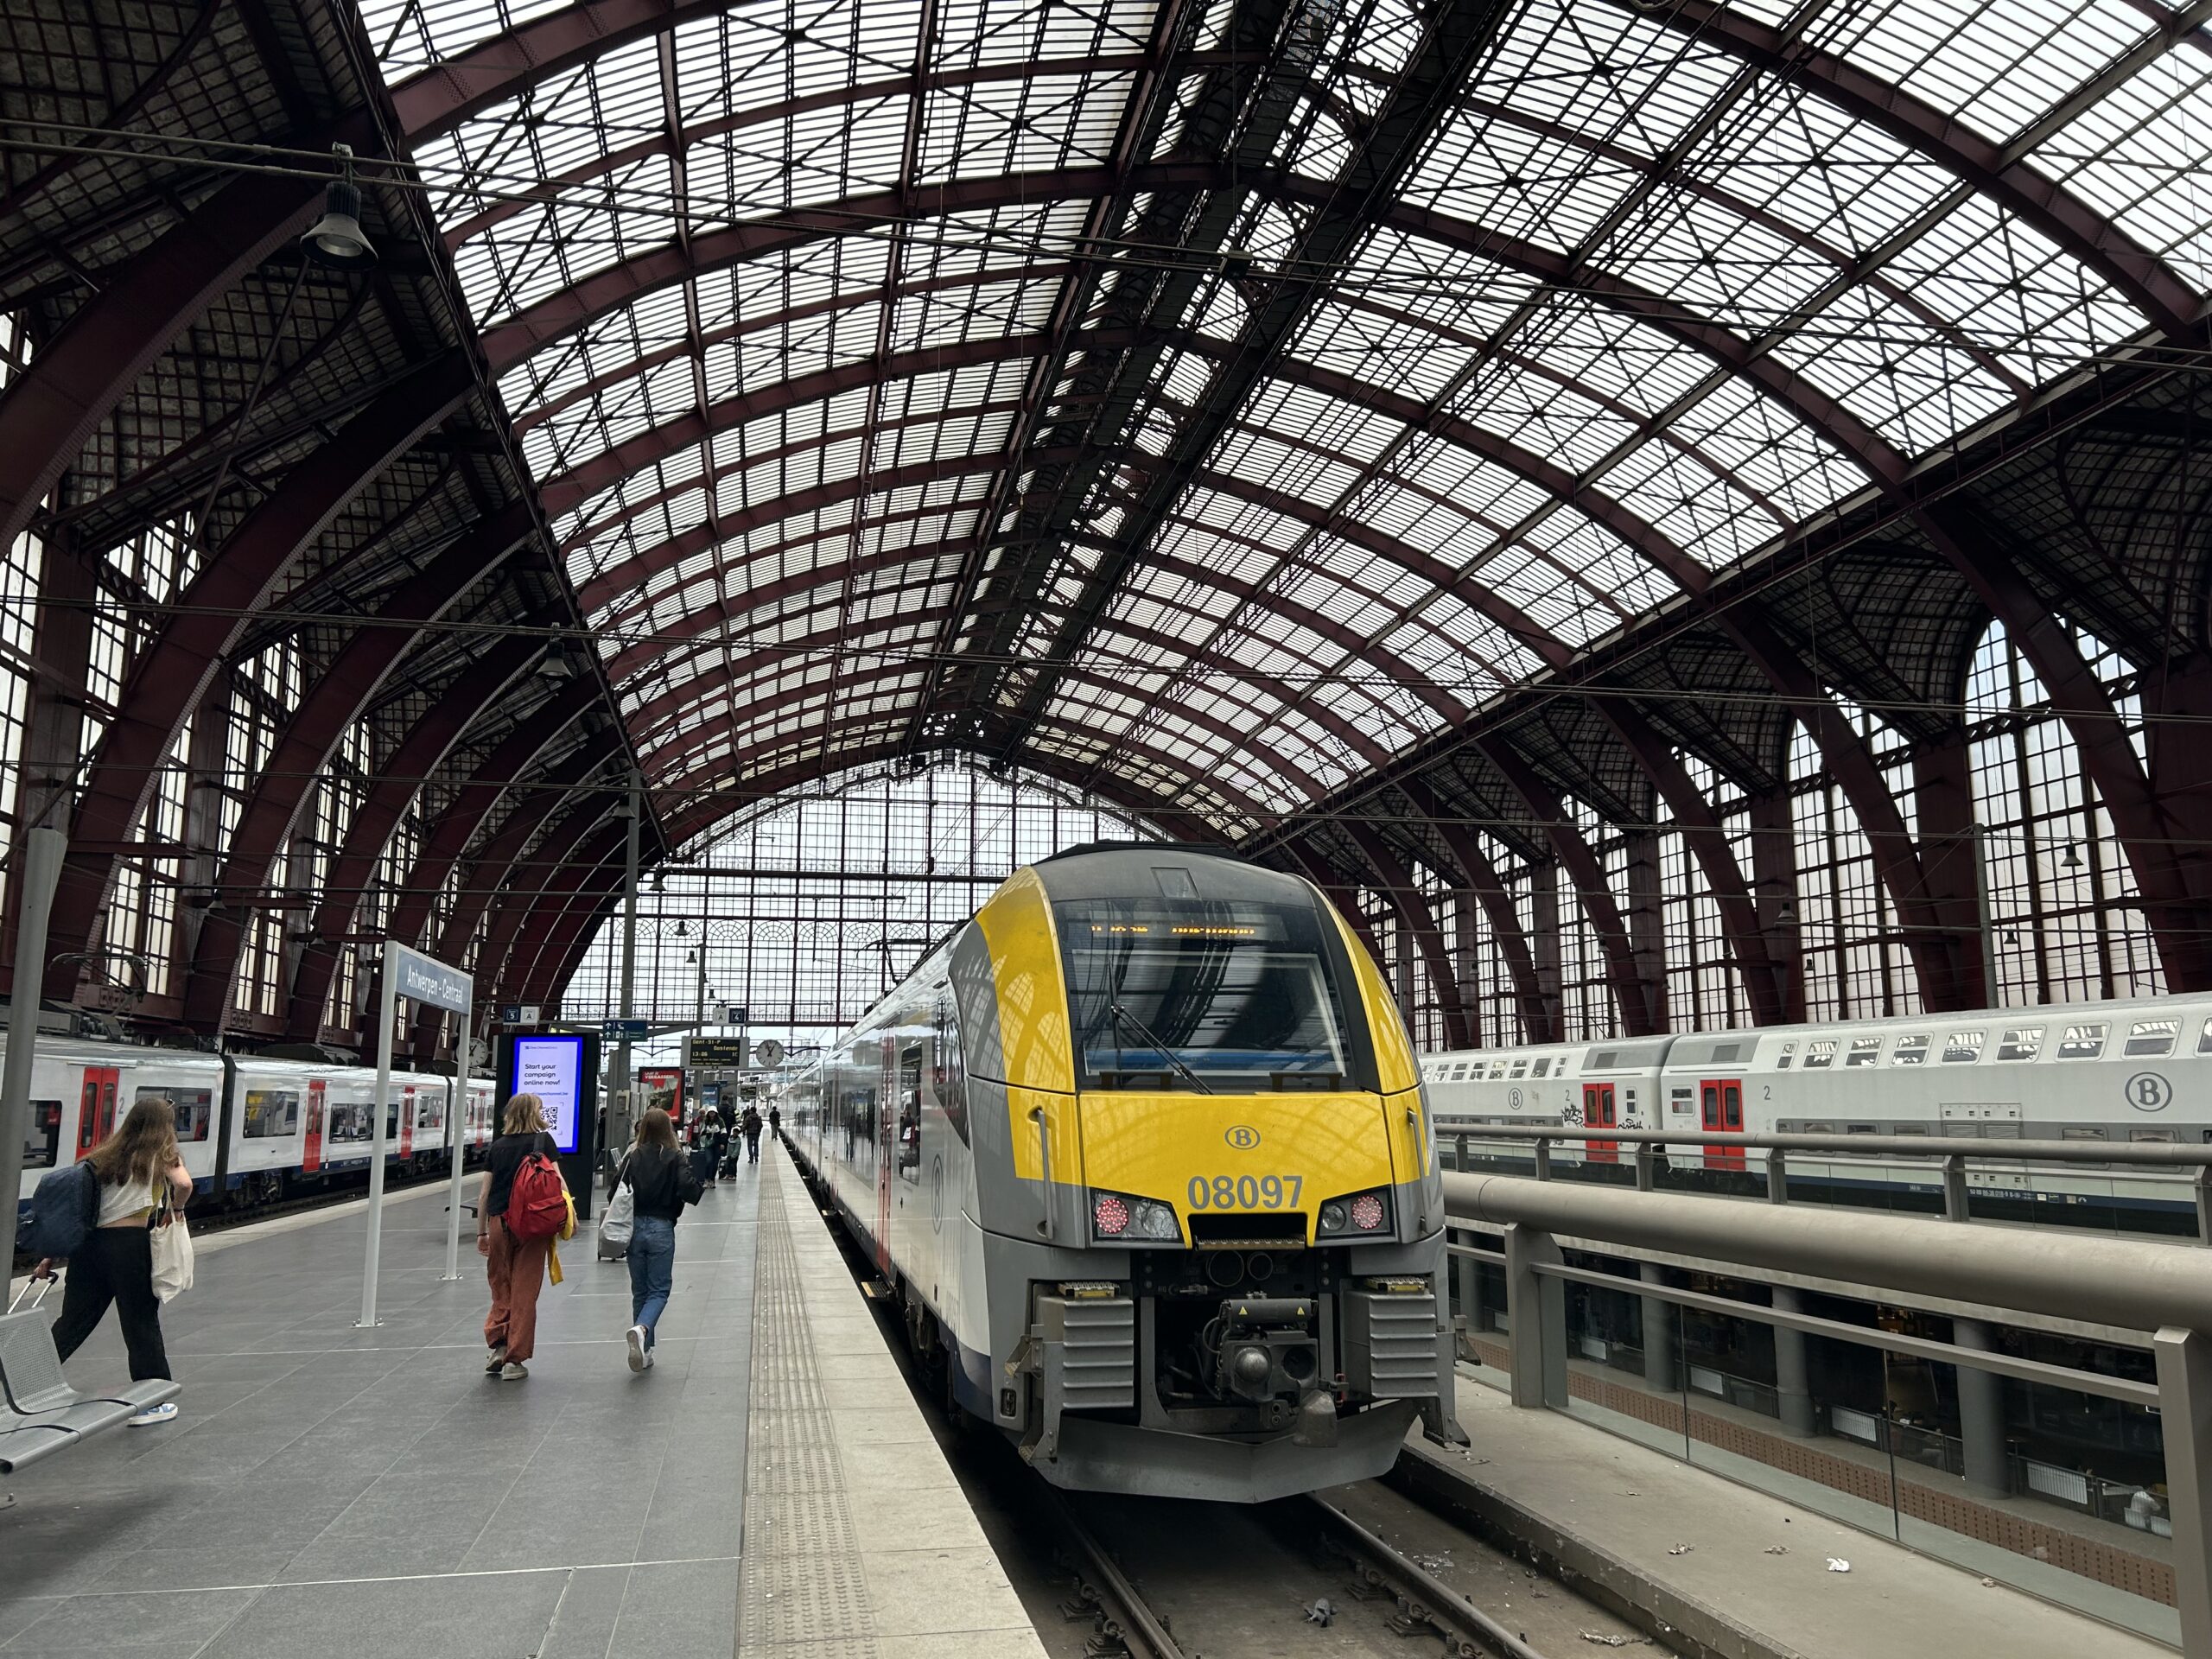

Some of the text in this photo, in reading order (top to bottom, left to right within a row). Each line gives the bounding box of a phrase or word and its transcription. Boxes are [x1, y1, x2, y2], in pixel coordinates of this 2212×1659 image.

[406, 963, 438, 999] Antwerpen
[442, 978, 463, 1003] Centraal
[1565, 1089, 1571, 1102] 2
[1764, 1085, 1771, 1100] 2
[118, 1096, 124, 1115] 2
[1188, 1175, 1303, 1210] 08097
